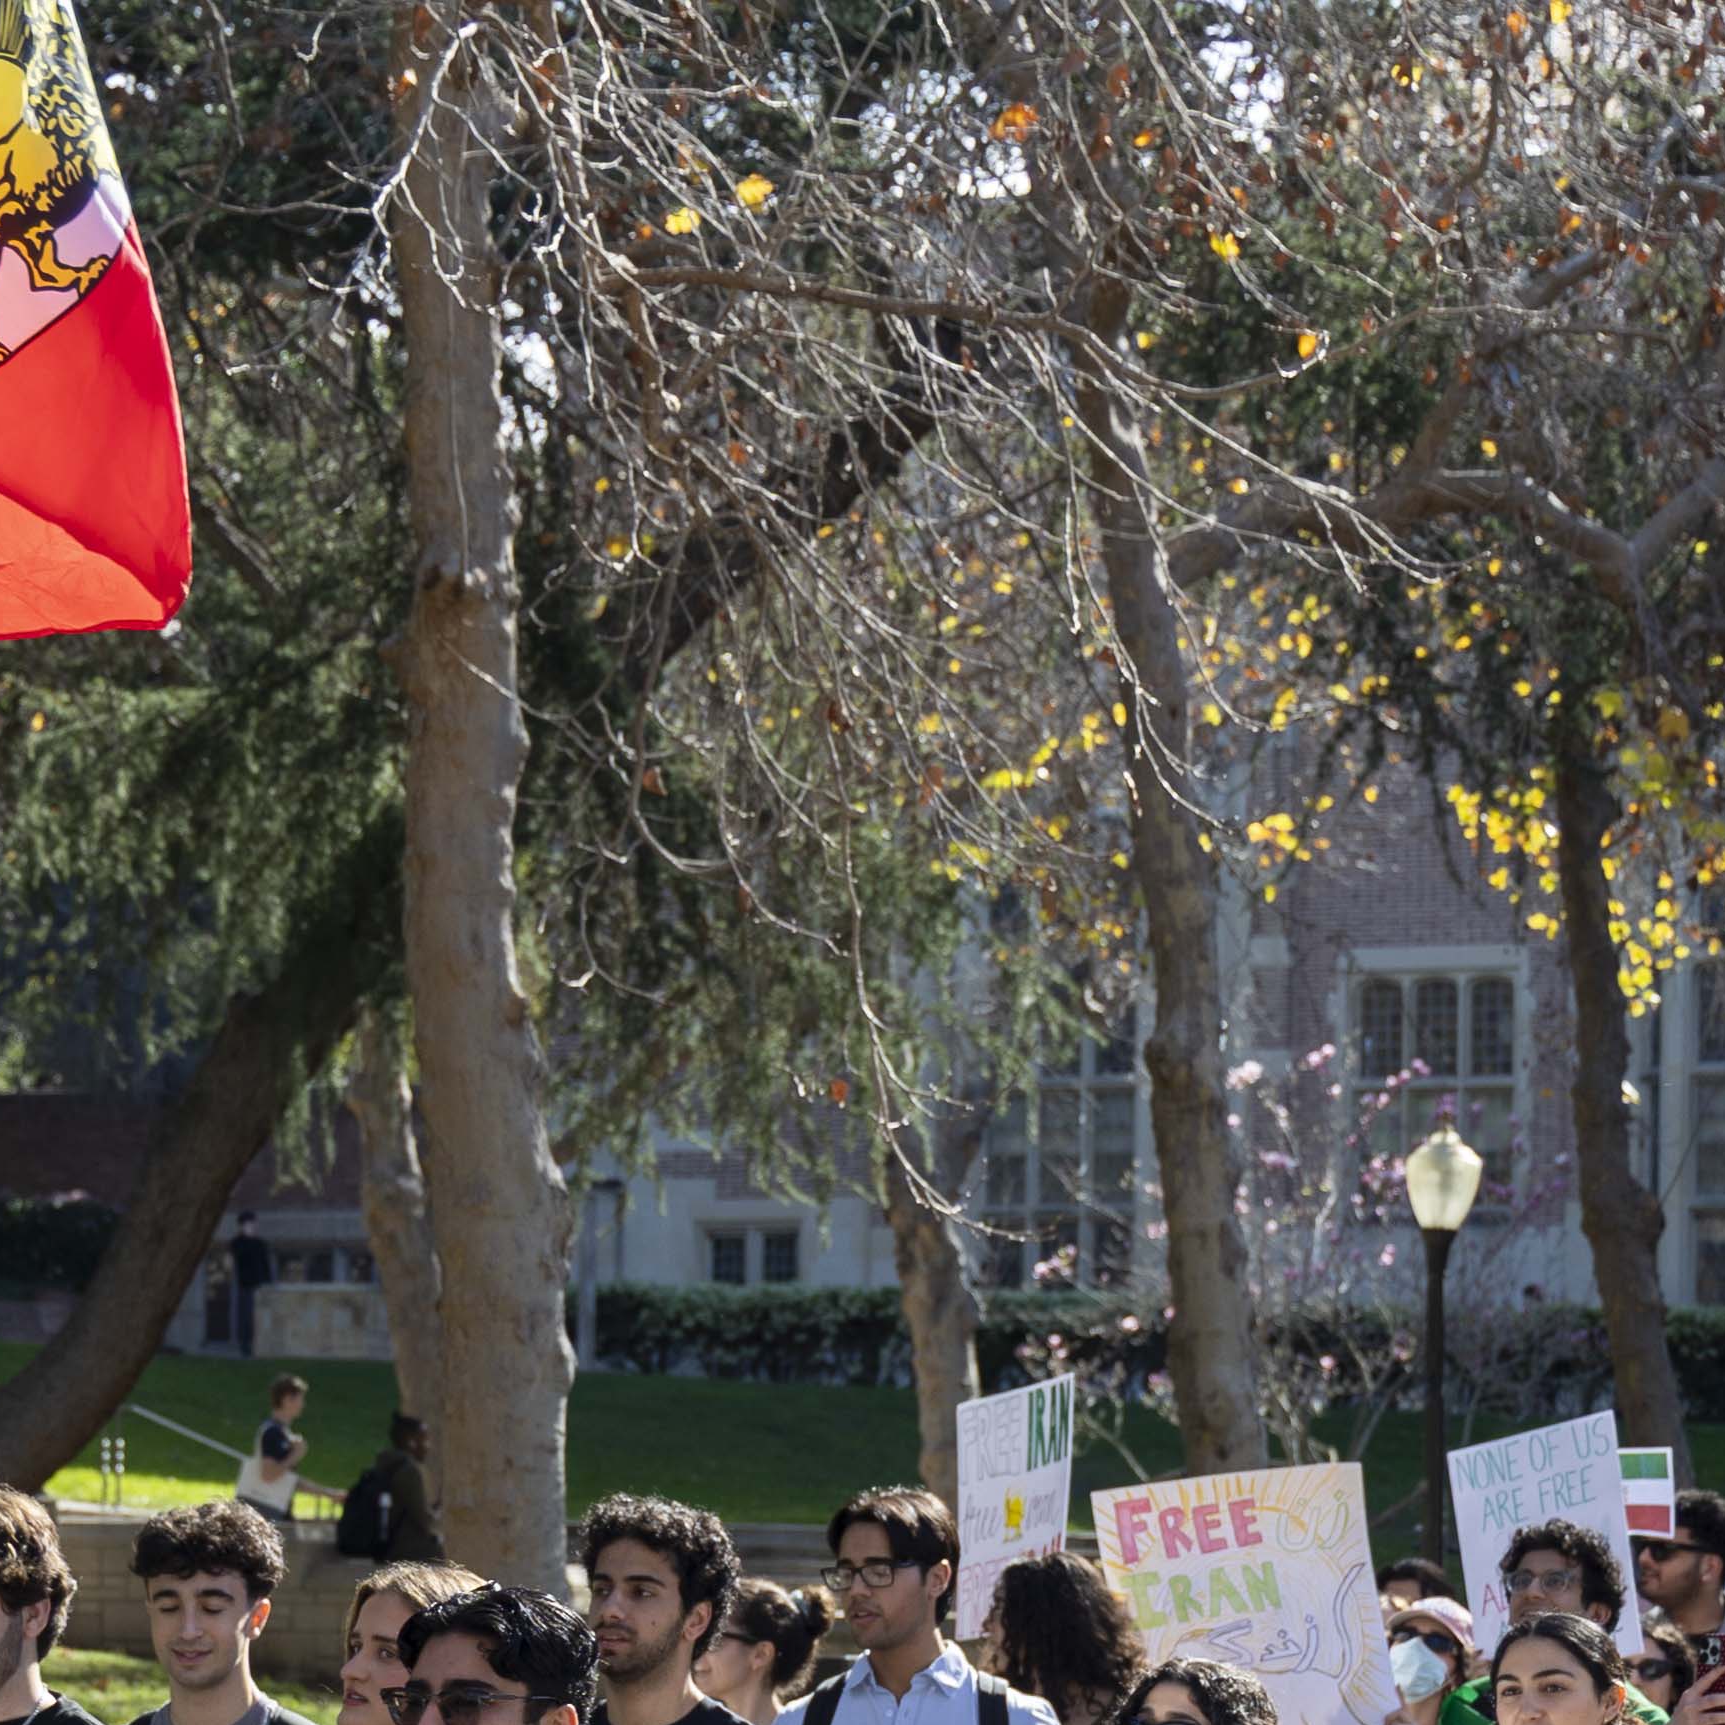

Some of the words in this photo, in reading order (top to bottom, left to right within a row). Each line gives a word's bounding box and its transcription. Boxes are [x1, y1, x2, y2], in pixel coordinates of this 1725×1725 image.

[962, 1395, 1022, 1487] FREE
[1026, 1379, 1071, 1472] IRAN
[1455, 1439, 1524, 1493] NONE
[1529, 1428, 1562, 1473] OF
[1571, 1416, 1611, 1461] US
[1114, 1496, 1263, 1565] FREE
[1482, 1487, 1526, 1534] ARE
[1537, 1464, 1596, 1514] FREE
[1118, 1561, 1282, 1633] IRAN
